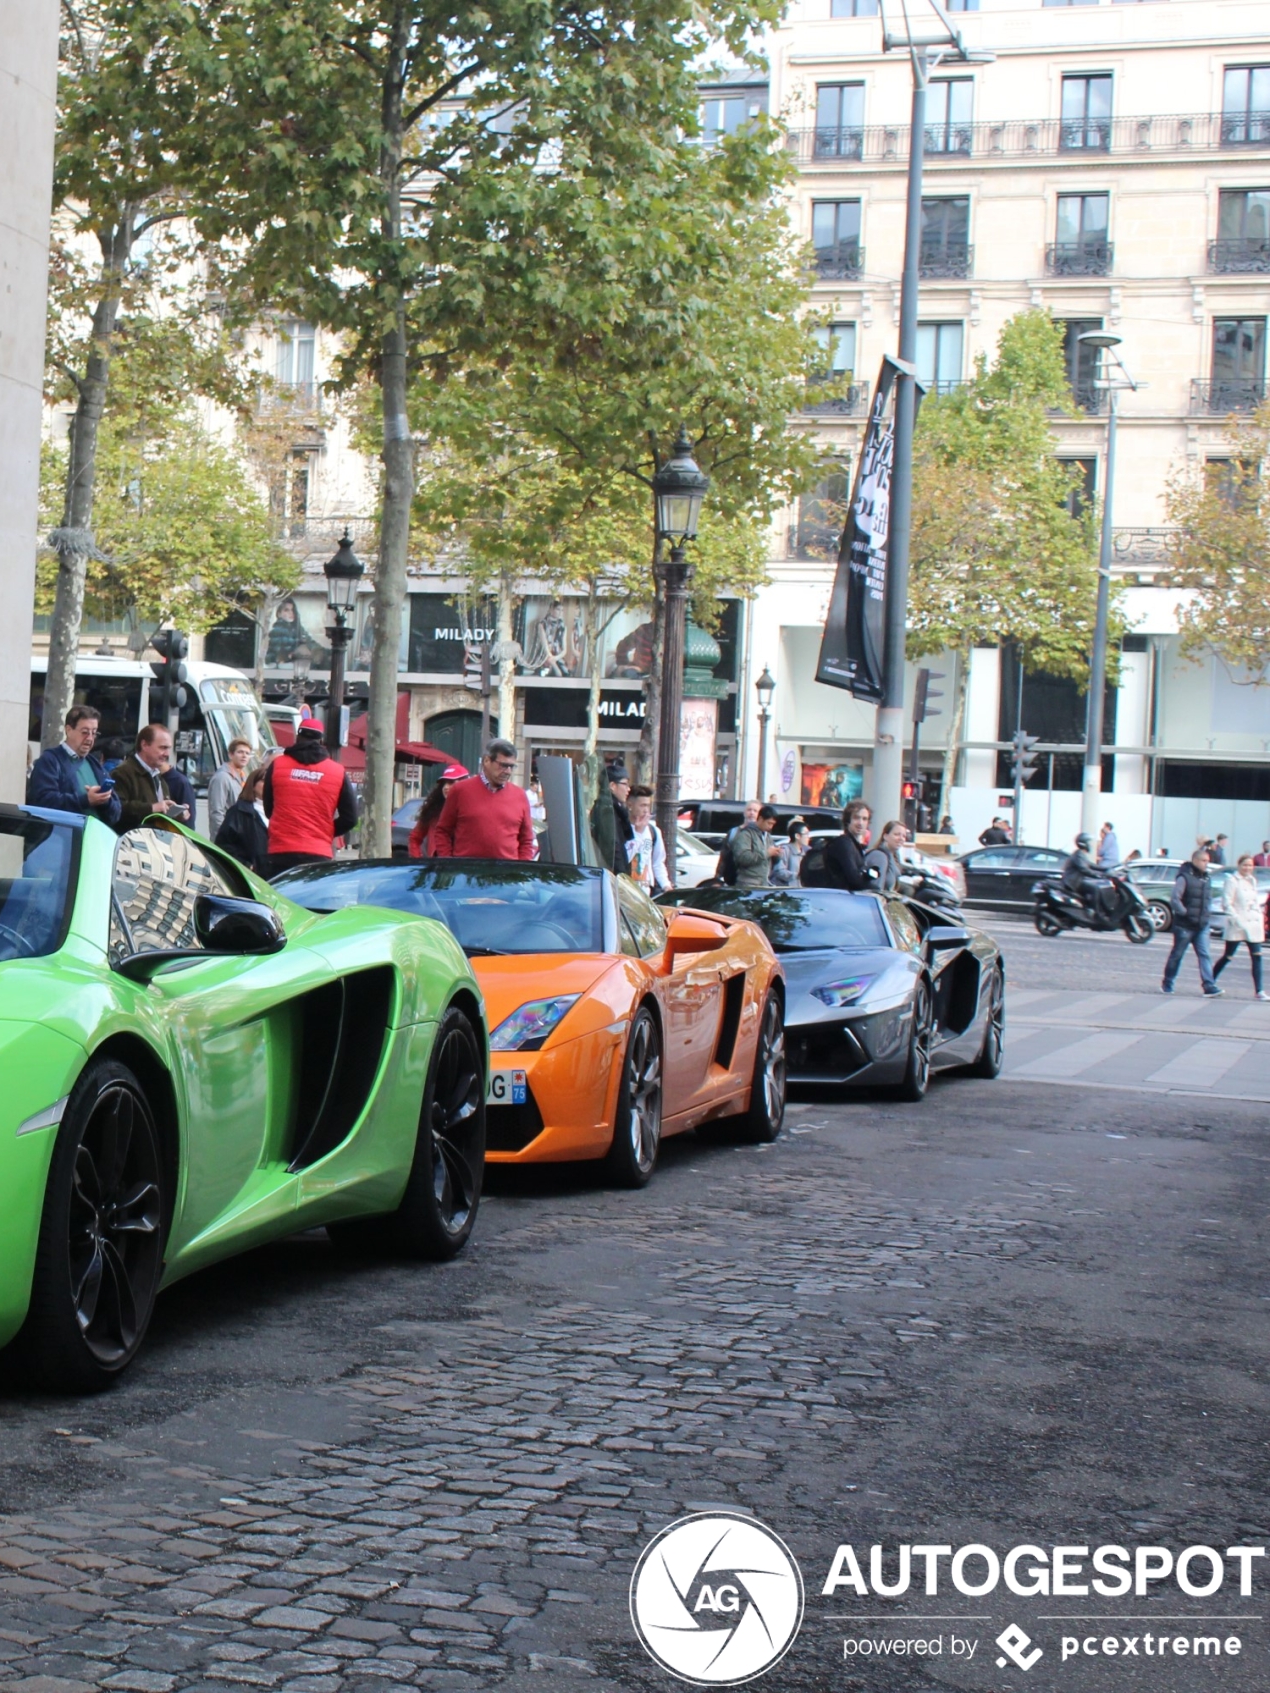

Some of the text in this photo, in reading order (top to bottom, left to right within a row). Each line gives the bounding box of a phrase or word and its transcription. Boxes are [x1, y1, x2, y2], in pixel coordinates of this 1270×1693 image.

[435, 628, 495, 640] MILADY
[597, 701, 646, 717] MILAD
[488, 1074, 506, 1099] G
[513, 1087, 525, 1100] 75
